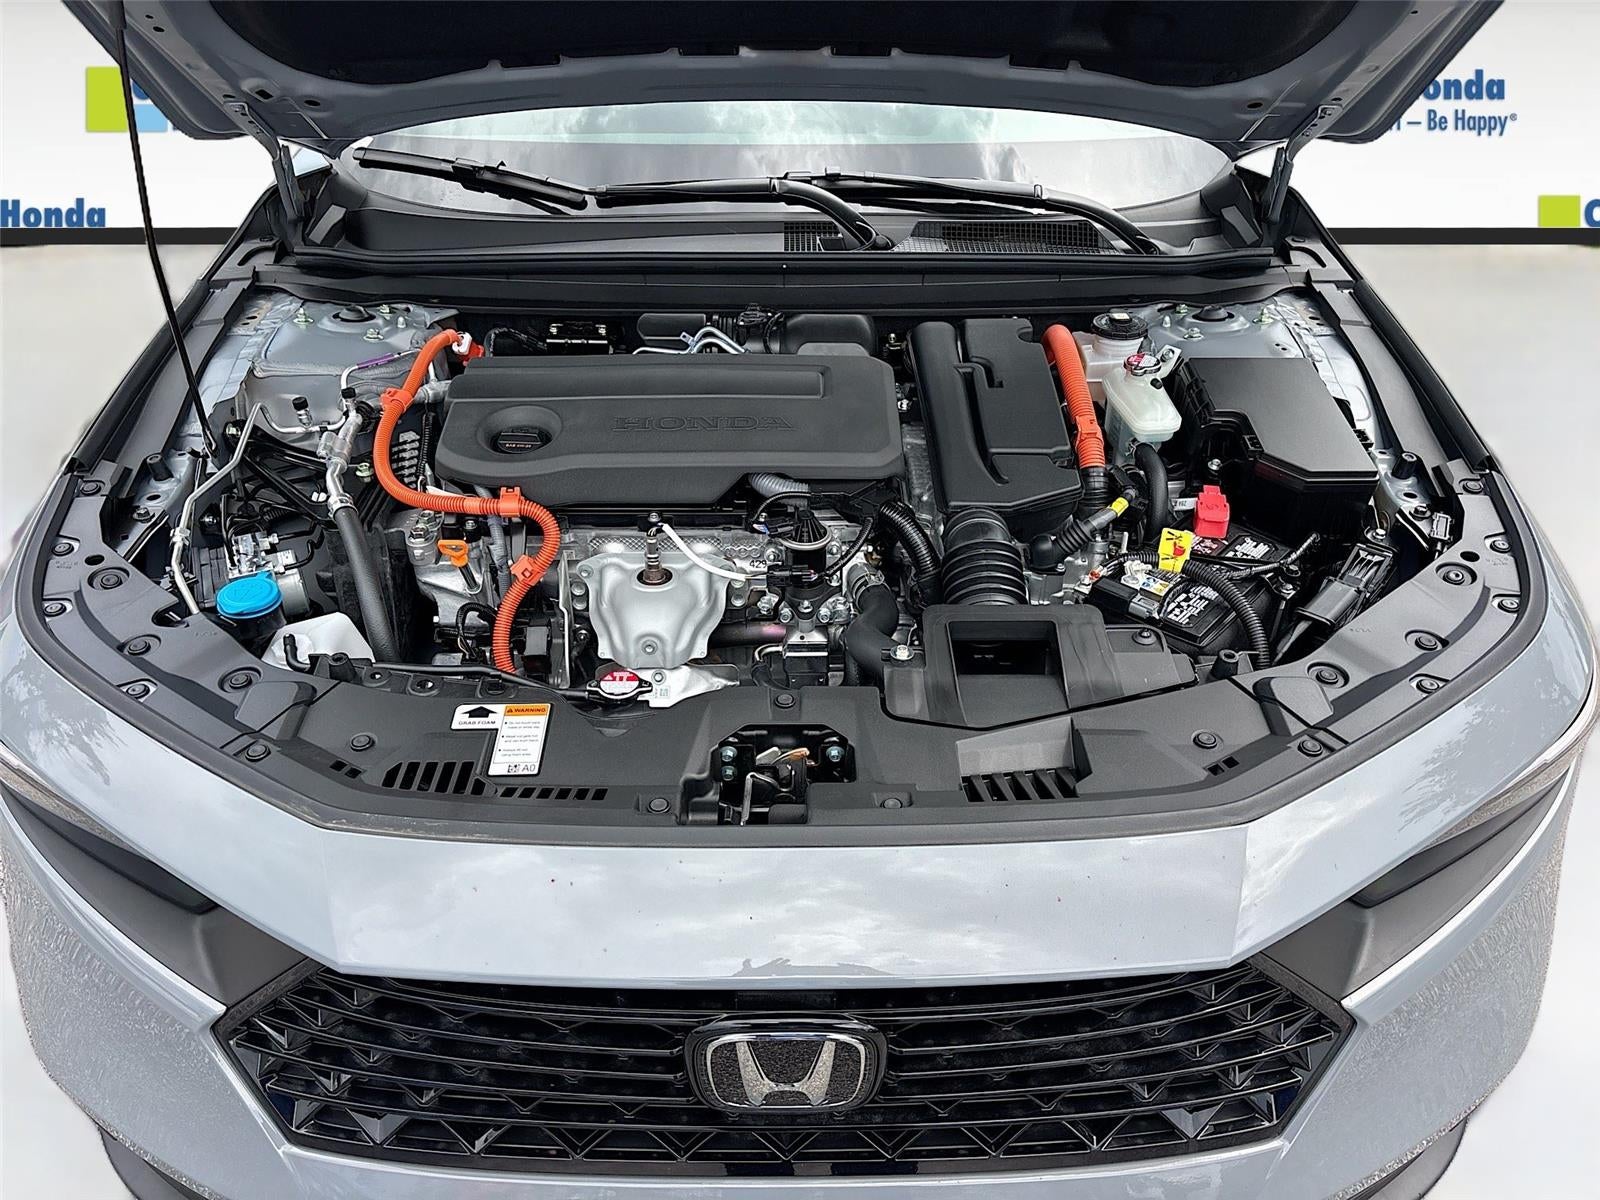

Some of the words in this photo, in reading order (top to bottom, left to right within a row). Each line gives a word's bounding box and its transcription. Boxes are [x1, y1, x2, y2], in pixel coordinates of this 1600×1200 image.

[1423, 69, 1505, 101] onda
[1427, 109, 1448, 131] Be
[0, 198, 106, 228] Honda
[612, 416, 797, 432] HONDA
